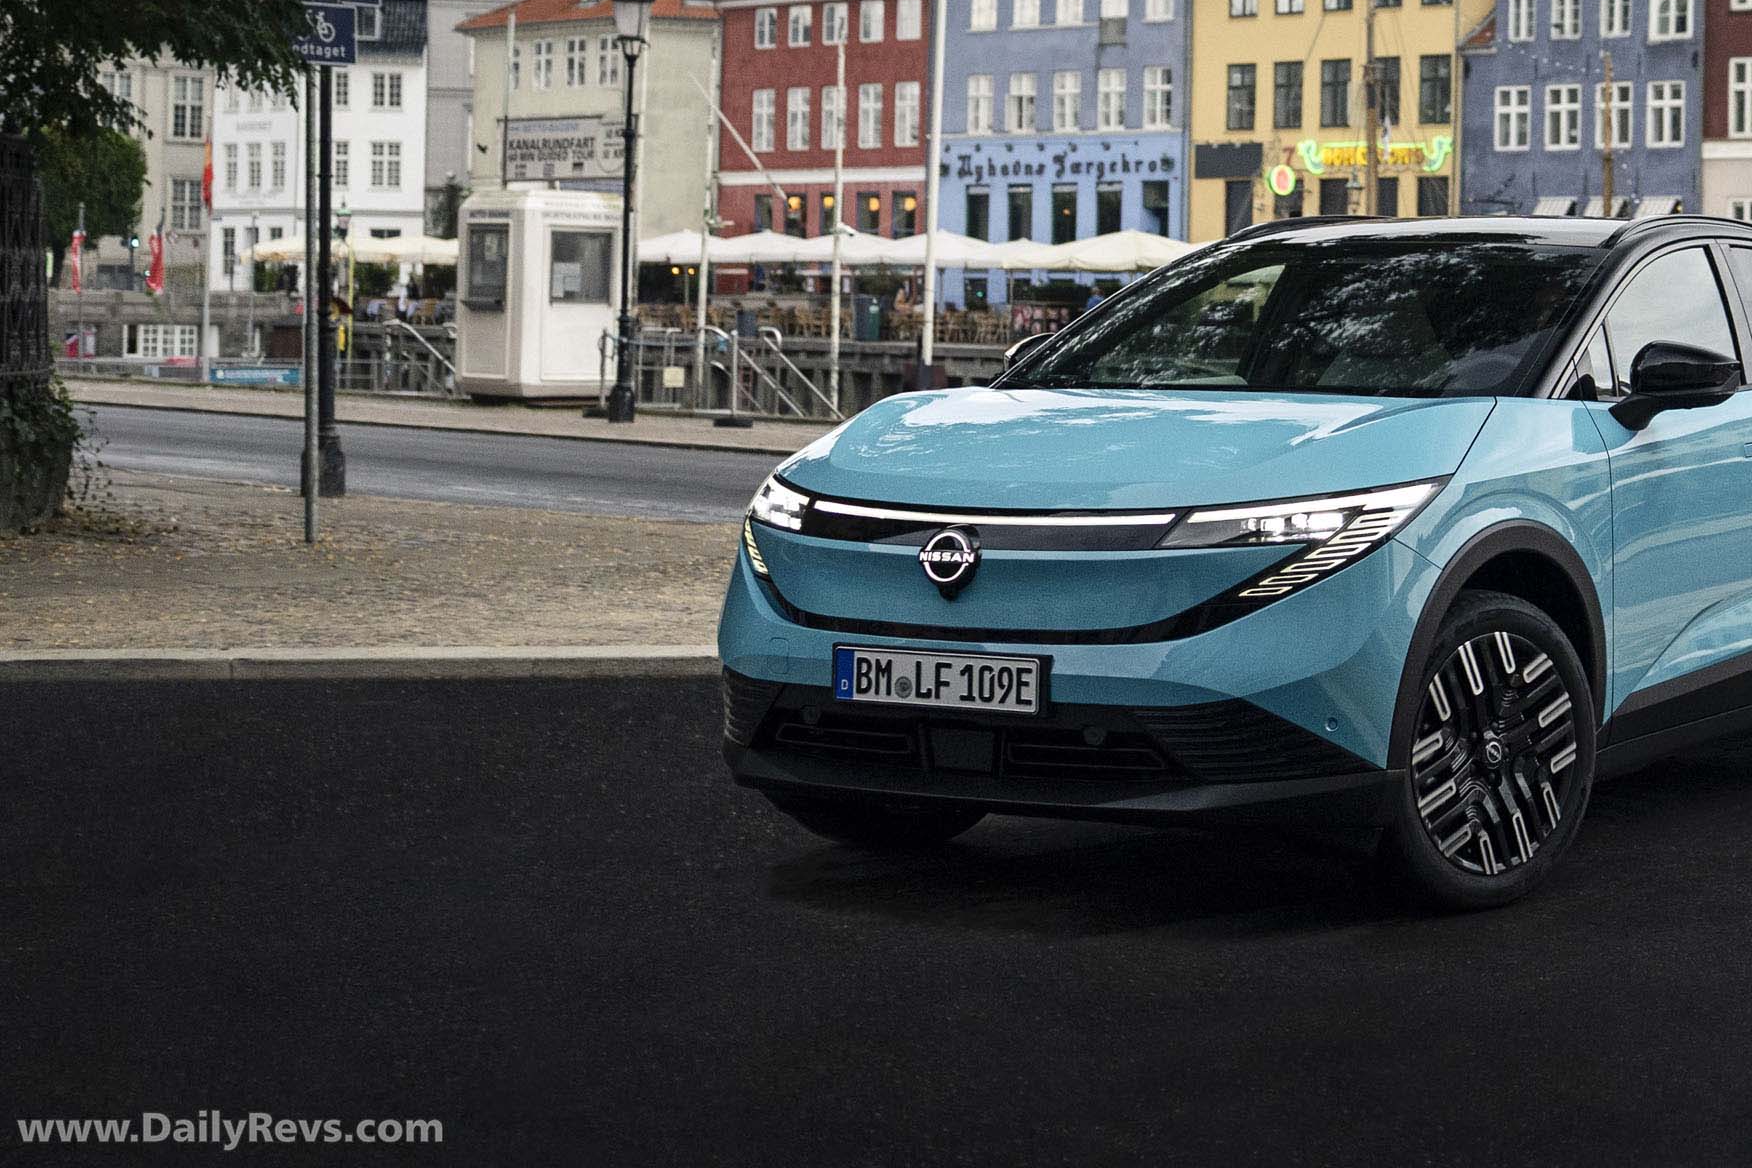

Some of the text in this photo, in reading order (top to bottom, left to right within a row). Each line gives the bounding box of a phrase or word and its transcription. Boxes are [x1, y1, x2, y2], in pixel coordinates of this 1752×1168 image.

[290, 43, 346, 58] ndtaget
[508, 136, 595, 151] KANALRUNDFART
[919, 550, 976, 564] NISSAN
[840, 679, 849, 691] D
[855, 656, 1034, 707] BM LF 109E
